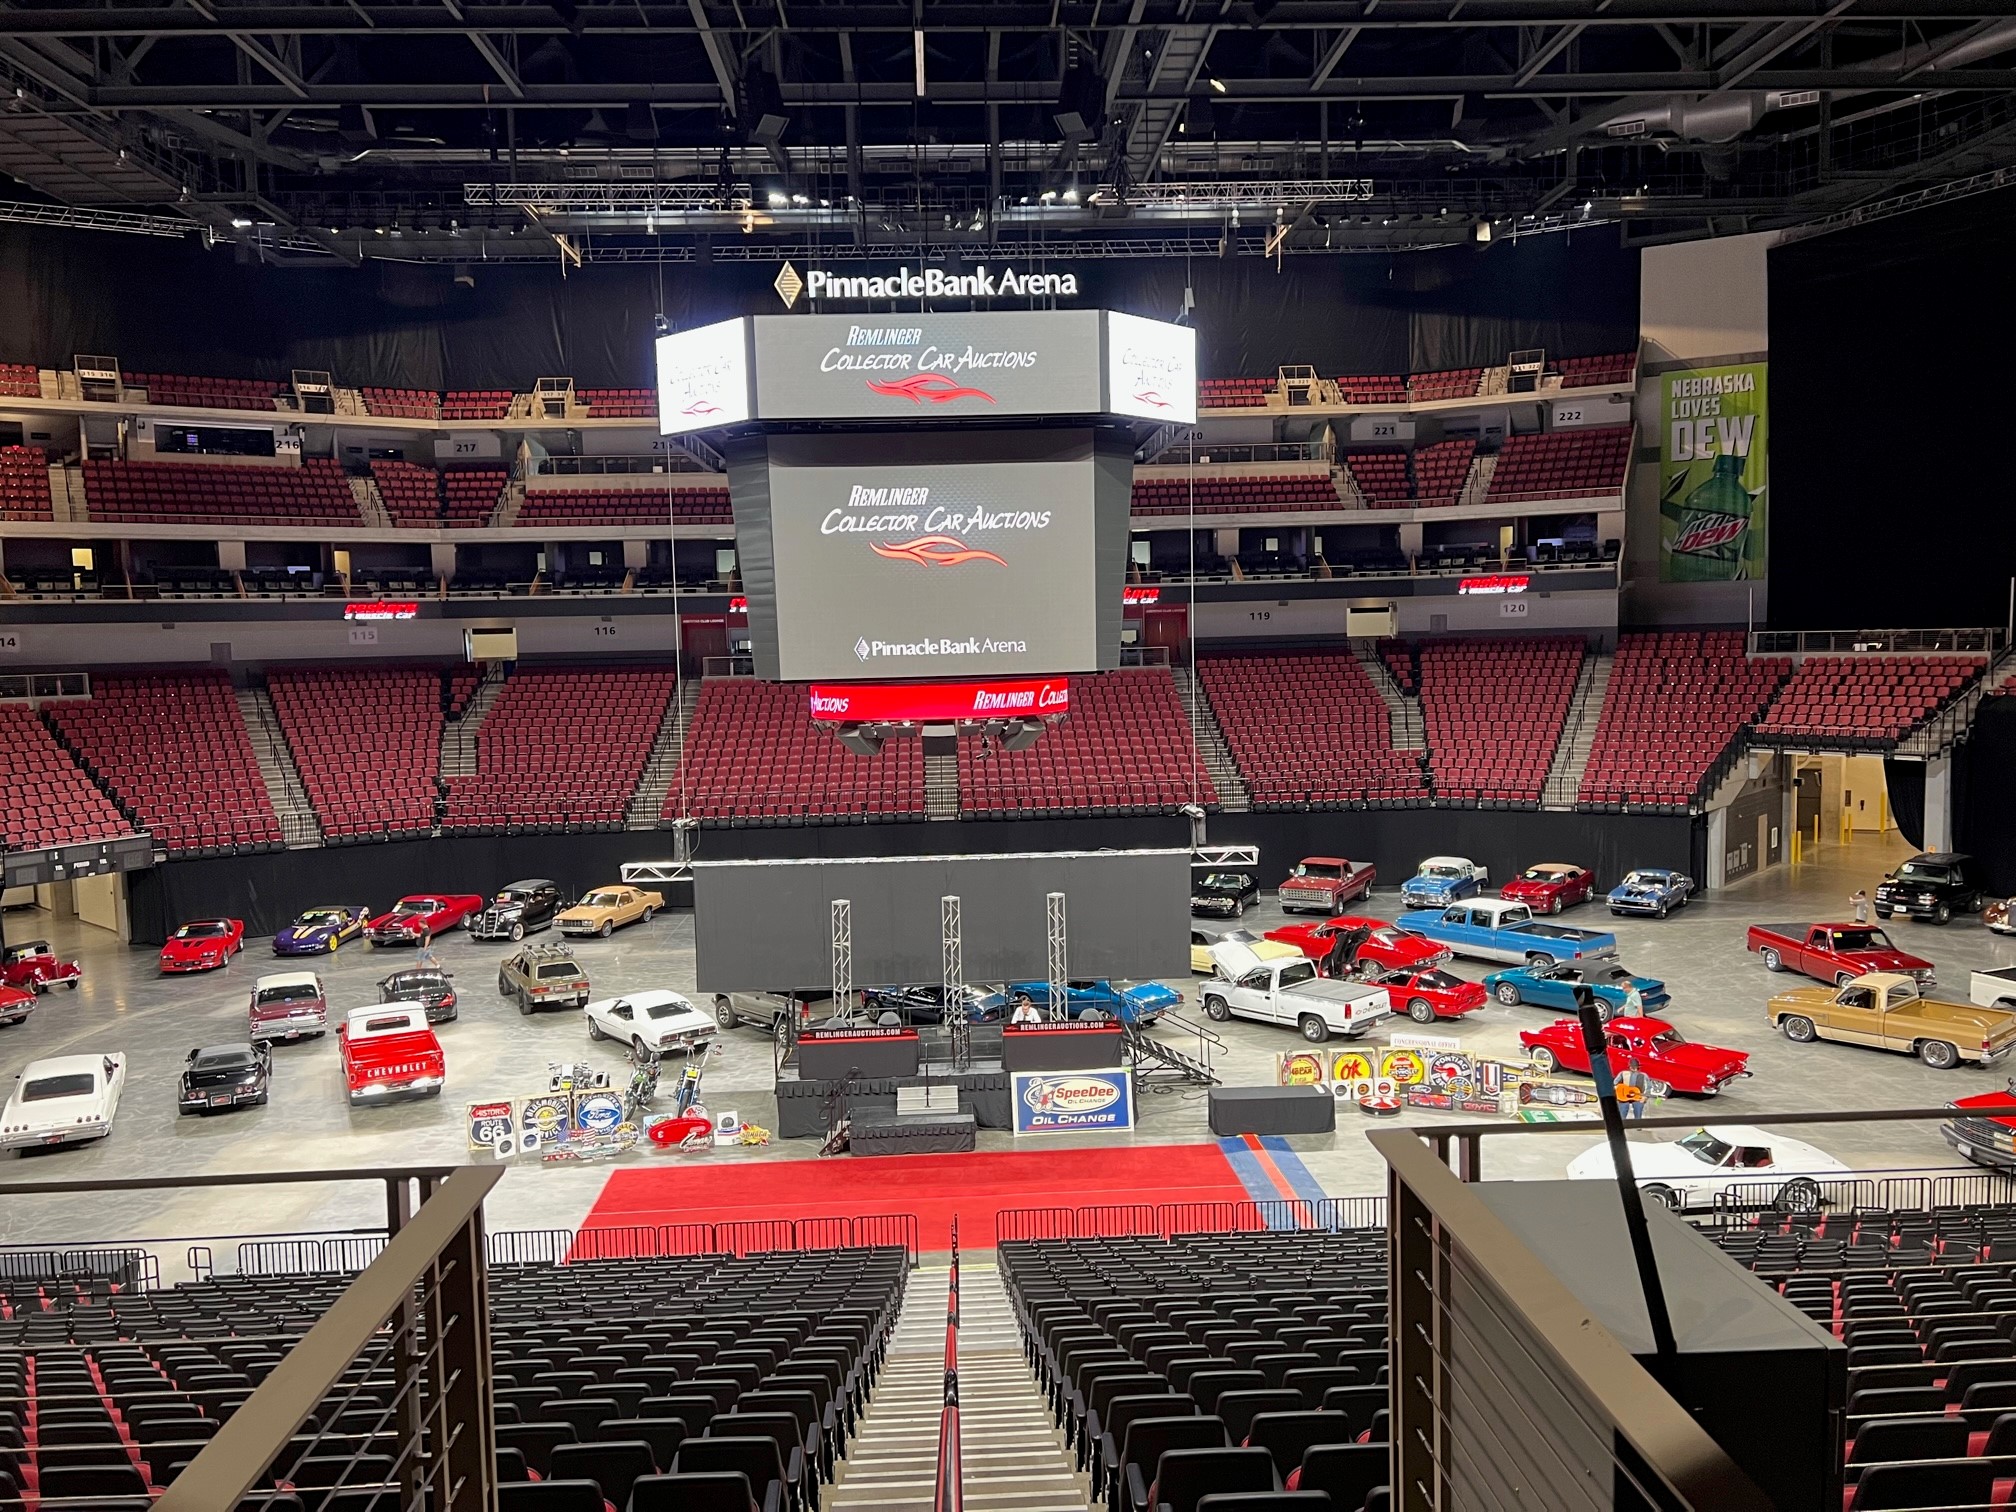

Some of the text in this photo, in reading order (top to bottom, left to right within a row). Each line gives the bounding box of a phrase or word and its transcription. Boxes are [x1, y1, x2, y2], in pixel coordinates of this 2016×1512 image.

[998, 267, 1078, 296] Arena
[846, 325, 922, 346] REMLINGER
[820, 346, 1037, 373] COLLECTOR CAR AUCTIONS
[1671, 373, 1755, 399] NEBRASKA
[1559, 411, 1581, 420] 222
[1671, 397, 1721, 419] LOVES
[1374, 426, 1396, 435] 221
[276, 440, 300, 450] 216
[1671, 415, 1756, 462] DEW
[456, 443, 476, 453] 217
[848, 485, 929, 506] REMLINGER
[820, 505, 1051, 534] COLLECTOR CAR AUCTIONS
[1504, 604, 1525, 613] 120
[1249, 612, 1270, 621] 119
[352, 631, 375, 641] 115
[595, 627, 616, 636] 116
[982, 637, 1027, 653] Arena
[973, 690, 1035, 710] REMLINGER
[816, 1029, 900, 1038] REMLINGERAUCTIONS.COM
[1020, 1022, 1104, 1031] REMLINGERAUCTIONS.COM
[367, 1062, 427, 1078] CHEVROLET
[1340, 1059, 1362, 1080] OK
[1435, 1056, 1468, 1070] PONTIAC
[1056, 1086, 1114, 1100] SpeeDee
[526, 1099, 565, 1117] OLDSMOBILE
[587, 1110, 612, 1119] Ford
[1032, 1114, 1116, 1125] OIL CHANGE
[479, 1125, 505, 1142] 66
